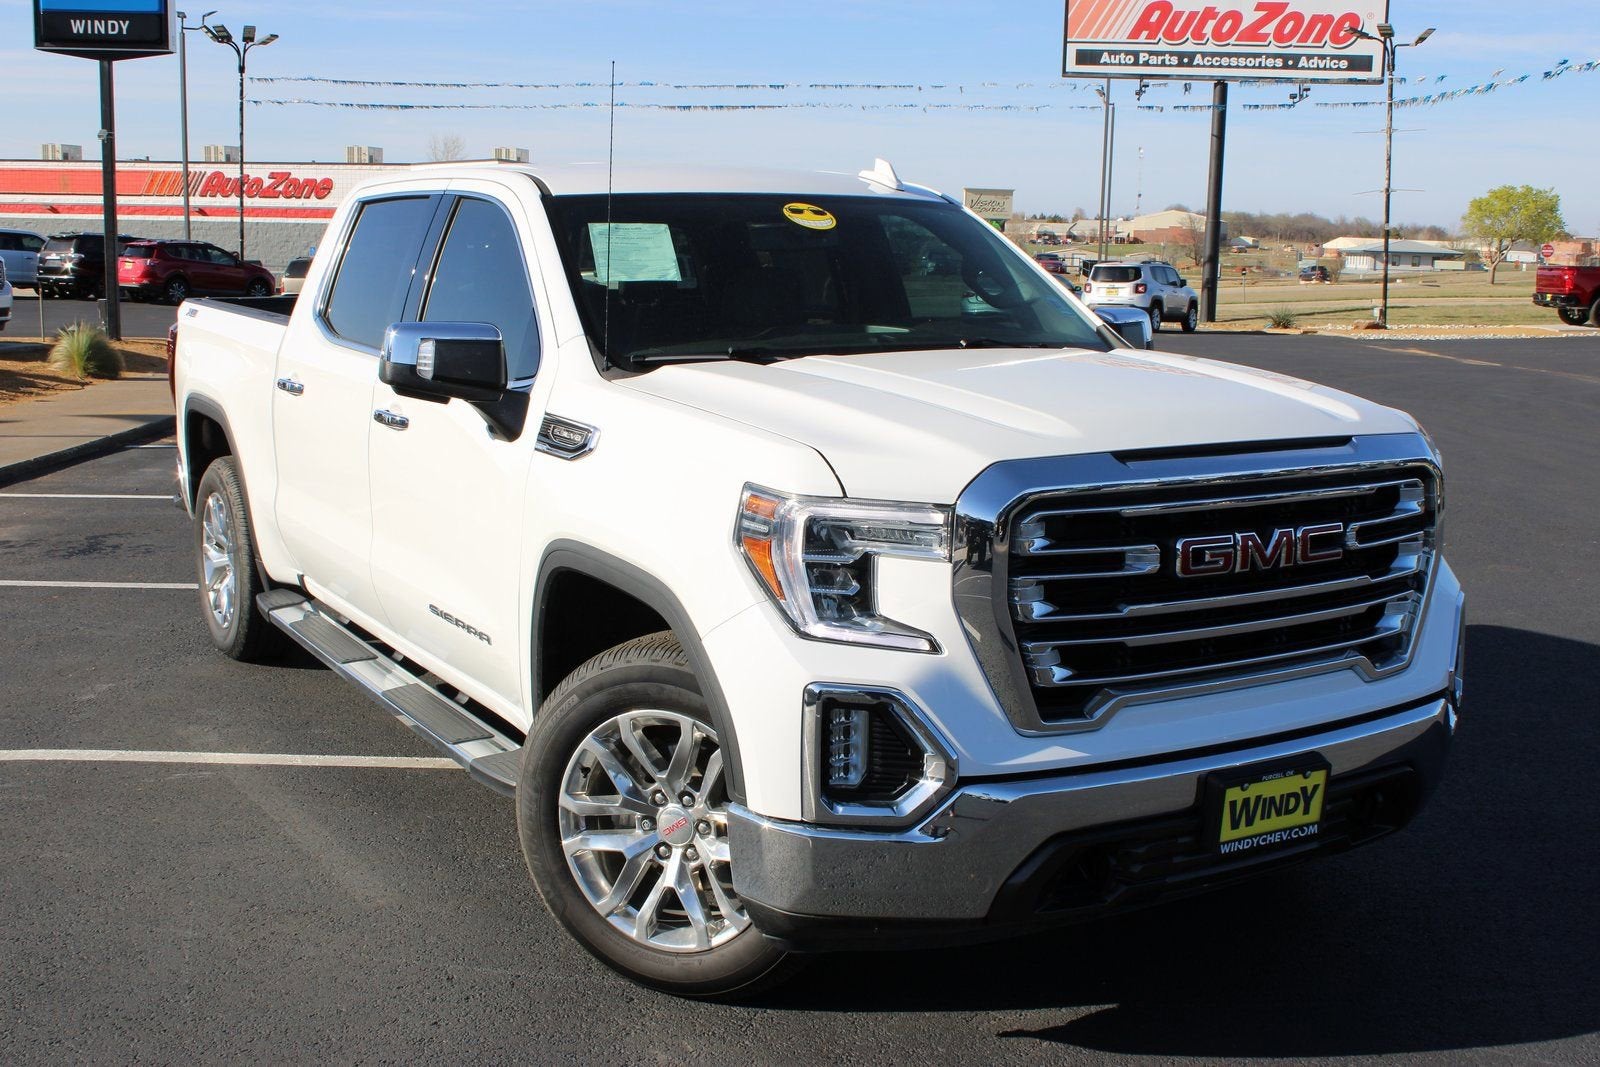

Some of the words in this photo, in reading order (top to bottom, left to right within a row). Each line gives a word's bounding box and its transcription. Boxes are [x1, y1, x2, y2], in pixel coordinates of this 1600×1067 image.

[70, 19, 130, 35] WINDY
[1126, 0, 1364, 48] AutoZone
[1100, 52, 1135, 64] Auto
[1138, 52, 1178, 66] Parts
[1193, 53, 1284, 67] Accessories
[1298, 56, 1348, 69] Advice
[199, 170, 333, 199] AutoZone
[1176, 522, 1343, 578] GMC
[429, 603, 492, 646] SIERRA
[1229, 783, 1320, 831] WINDY
[662, 816, 688, 836] GMC
[1220, 824, 1318, 854] WINDYCHEV.COM
